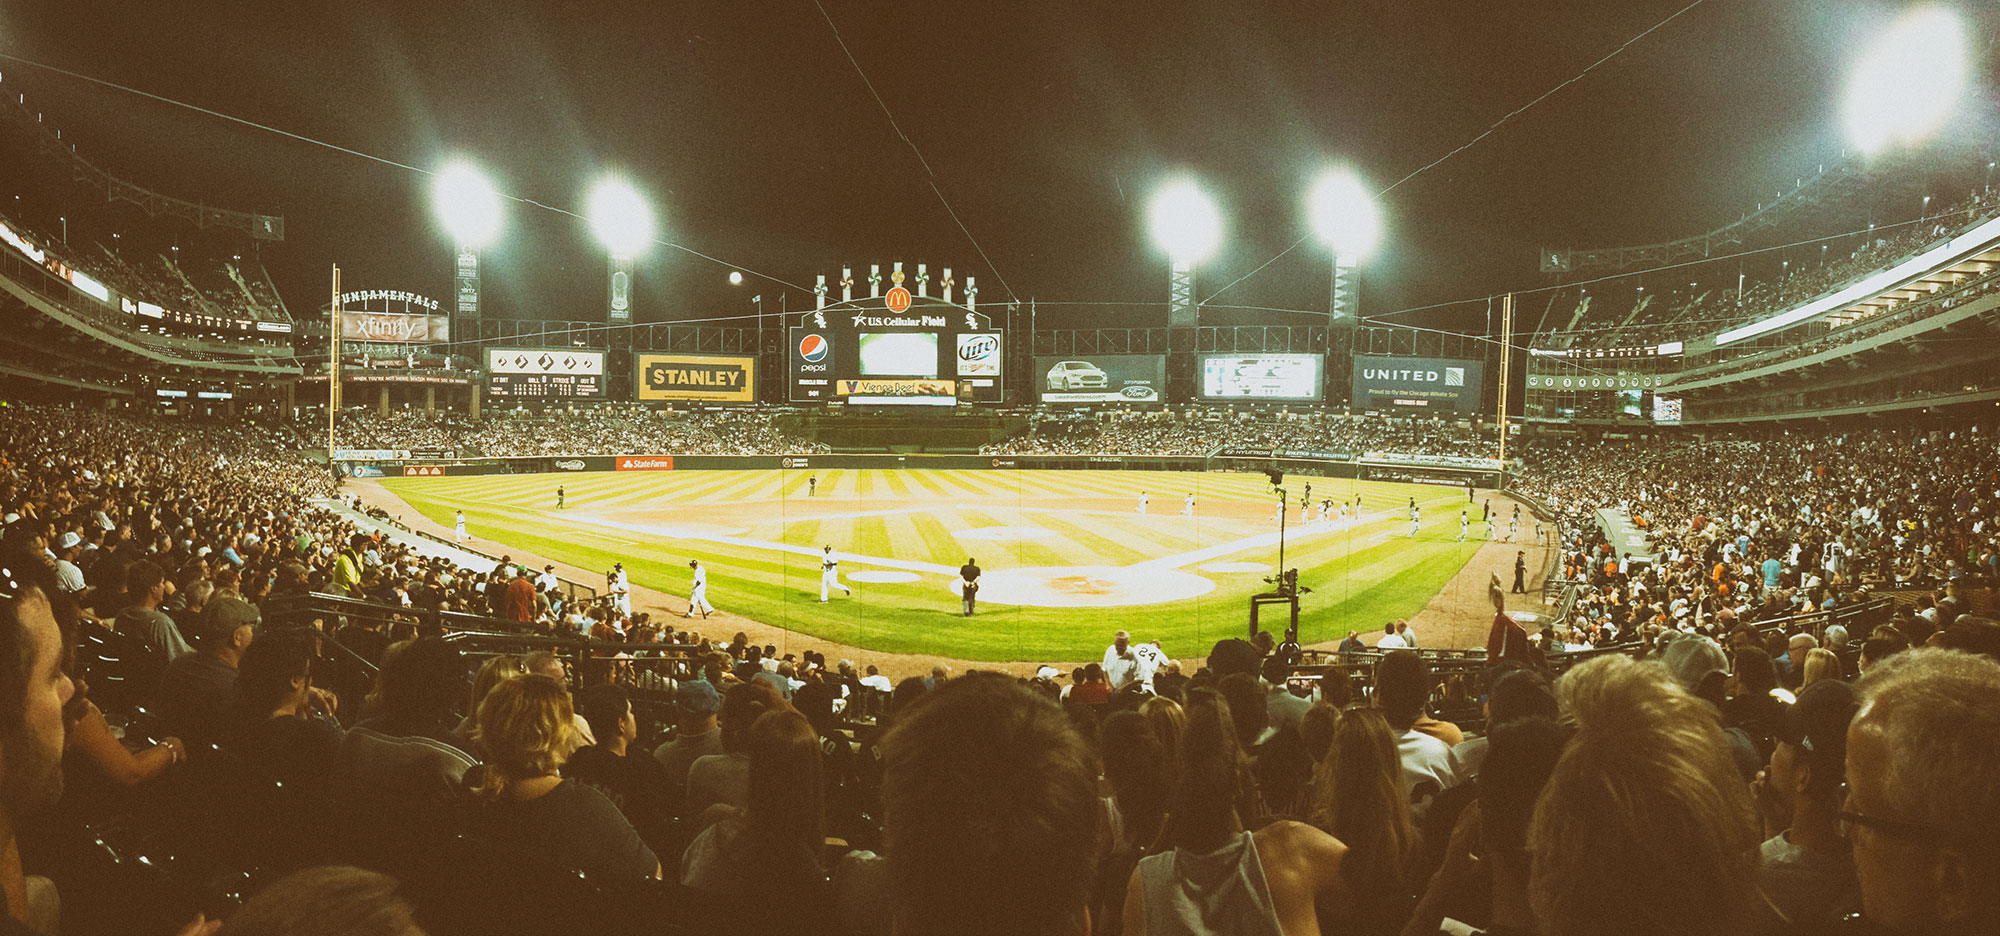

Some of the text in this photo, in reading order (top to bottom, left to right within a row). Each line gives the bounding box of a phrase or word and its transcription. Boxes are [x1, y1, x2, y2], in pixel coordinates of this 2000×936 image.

[884, 317, 921, 326] Cellular
[922, 315, 946, 327] Field
[357, 317, 416, 339] xfinity
[801, 364, 826, 372] pepsi
[653, 369, 739, 386] STANLEY
[1363, 369, 1438, 381] UNITED
[861, 381, 916, 392] Vienna Beef
[1126, 388, 1148, 397] Ford
[1138, 647, 1157, 662] 24
